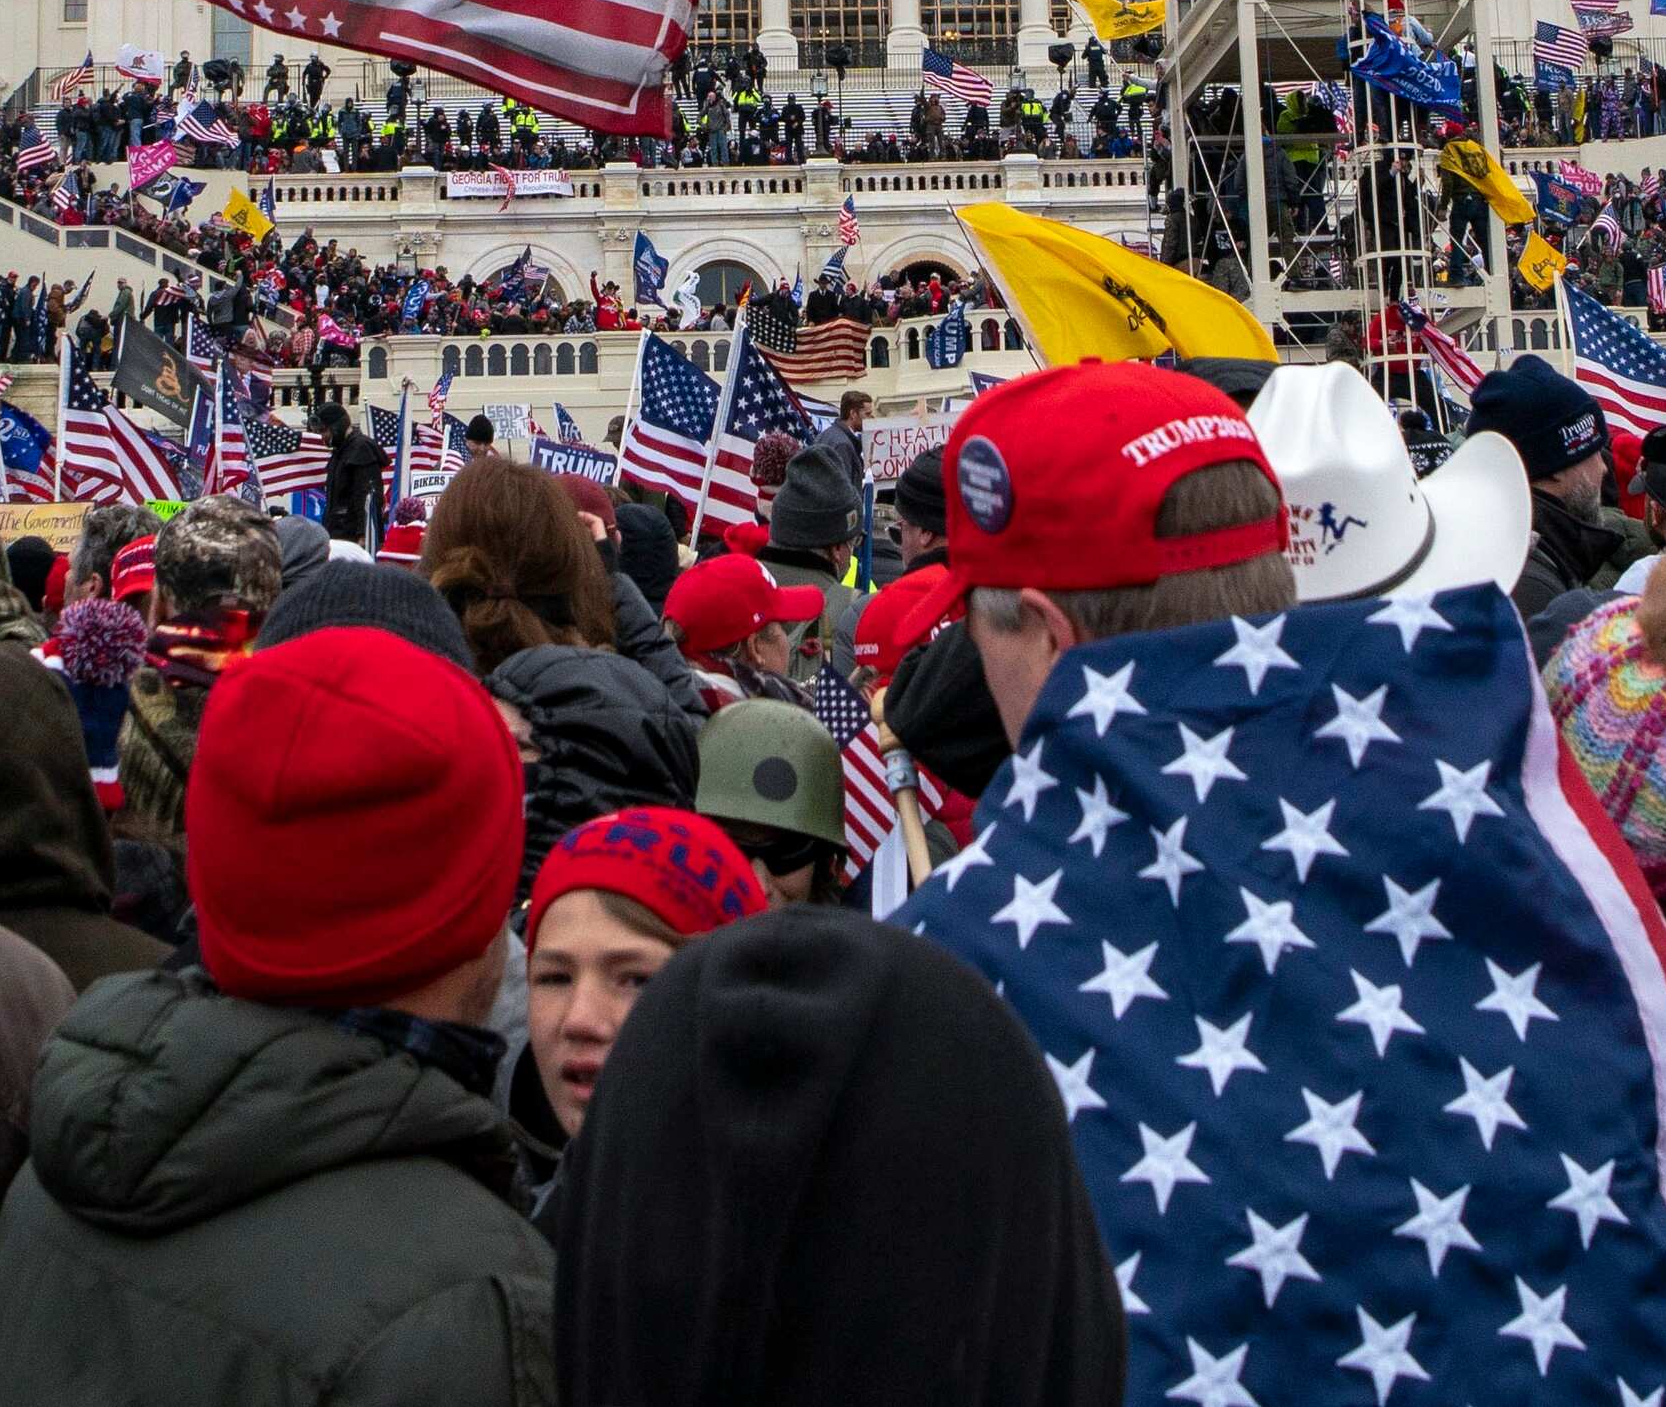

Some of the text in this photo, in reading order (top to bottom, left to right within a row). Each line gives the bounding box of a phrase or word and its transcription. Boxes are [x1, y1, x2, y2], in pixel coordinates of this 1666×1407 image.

[452, 172, 492, 185] GEORGIA
[494, 171, 520, 185] FIGT
[522, 170, 541, 184] FOR
[944, 305, 961, 365] RUMP
[486, 405, 524, 419] SEND
[538, 448, 616, 483] TRUMP
[413, 476, 446, 491] BIKERS
